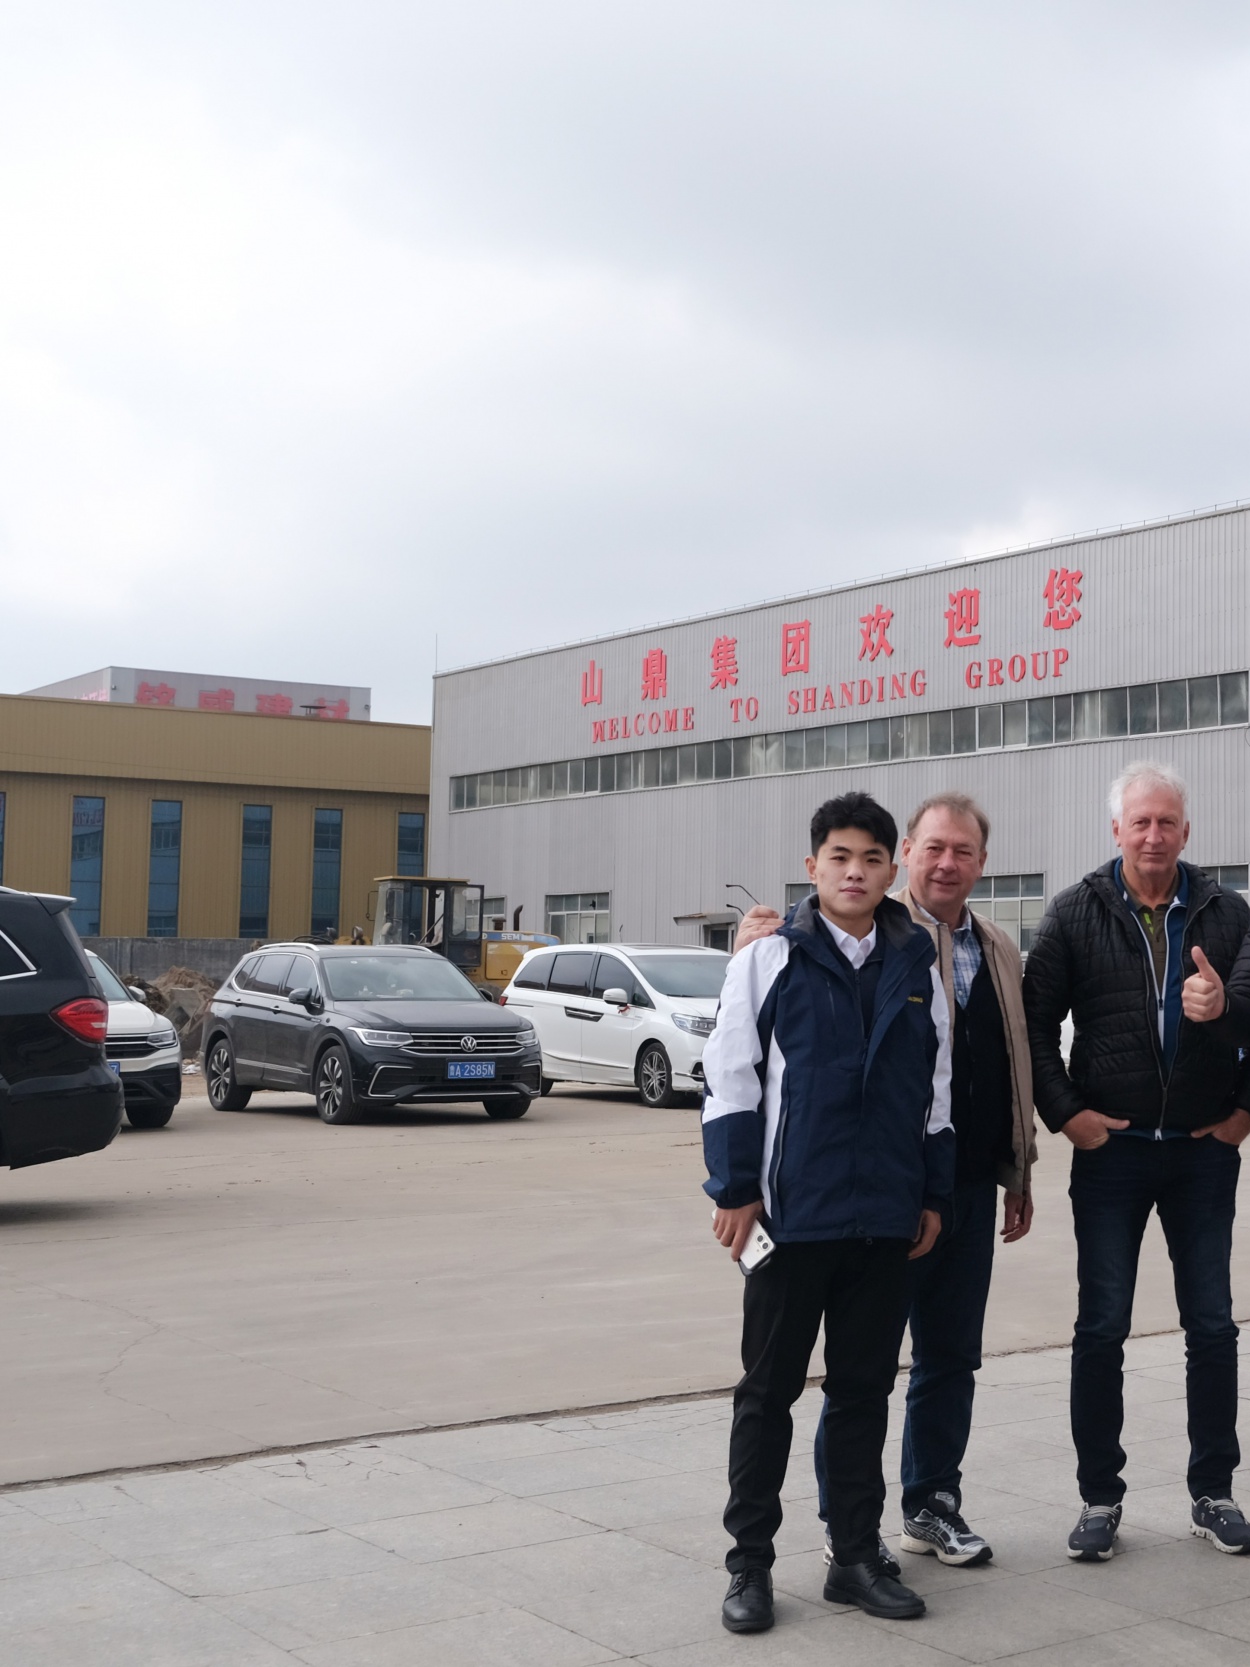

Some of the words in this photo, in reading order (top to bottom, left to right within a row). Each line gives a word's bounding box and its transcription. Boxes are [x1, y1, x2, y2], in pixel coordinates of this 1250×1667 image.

[580, 567, 1084, 707] 山鼎集团欢迎您
[592, 706, 695, 744] WELCOME
[730, 696, 759, 723] TO
[787, 669, 927, 716] SHANDING
[965, 647, 1069, 690] GROUP
[501, 932, 520, 941] SEM
